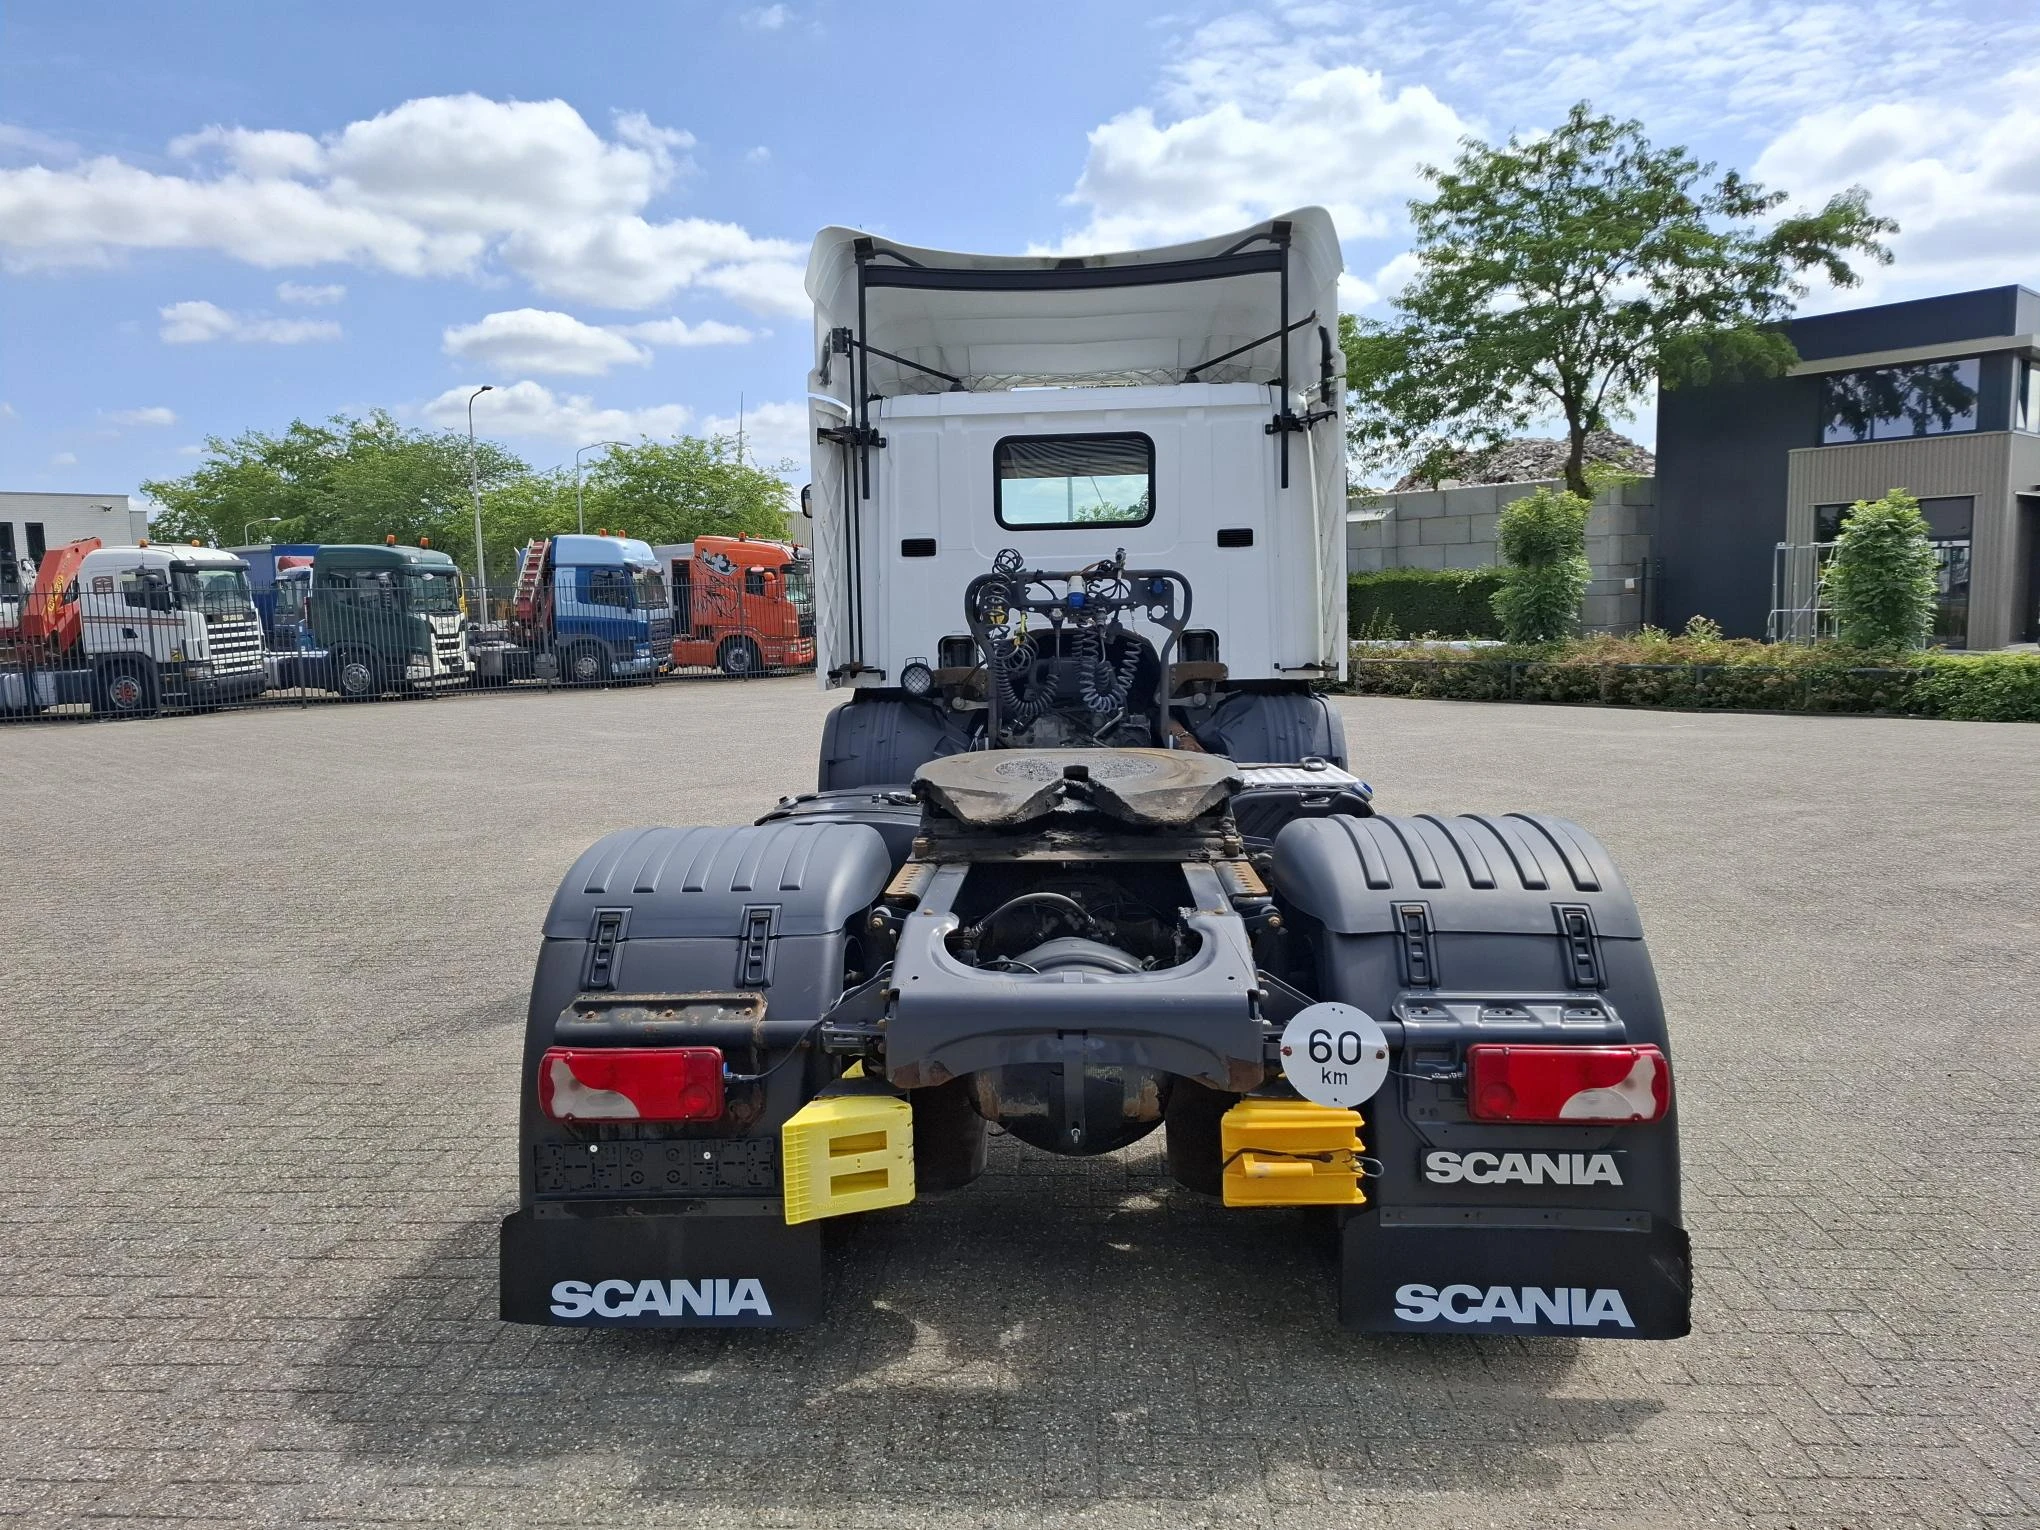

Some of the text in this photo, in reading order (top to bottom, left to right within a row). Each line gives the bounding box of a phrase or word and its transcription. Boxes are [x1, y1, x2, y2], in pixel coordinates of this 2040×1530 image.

[1309, 1029, 1361, 1065] 60
[1322, 1067, 1347, 1085] km
[1426, 1151, 1623, 1185] SCANIA
[550, 1279, 772, 1317] SCANIA
[1394, 1284, 1635, 1327] SCANIA
